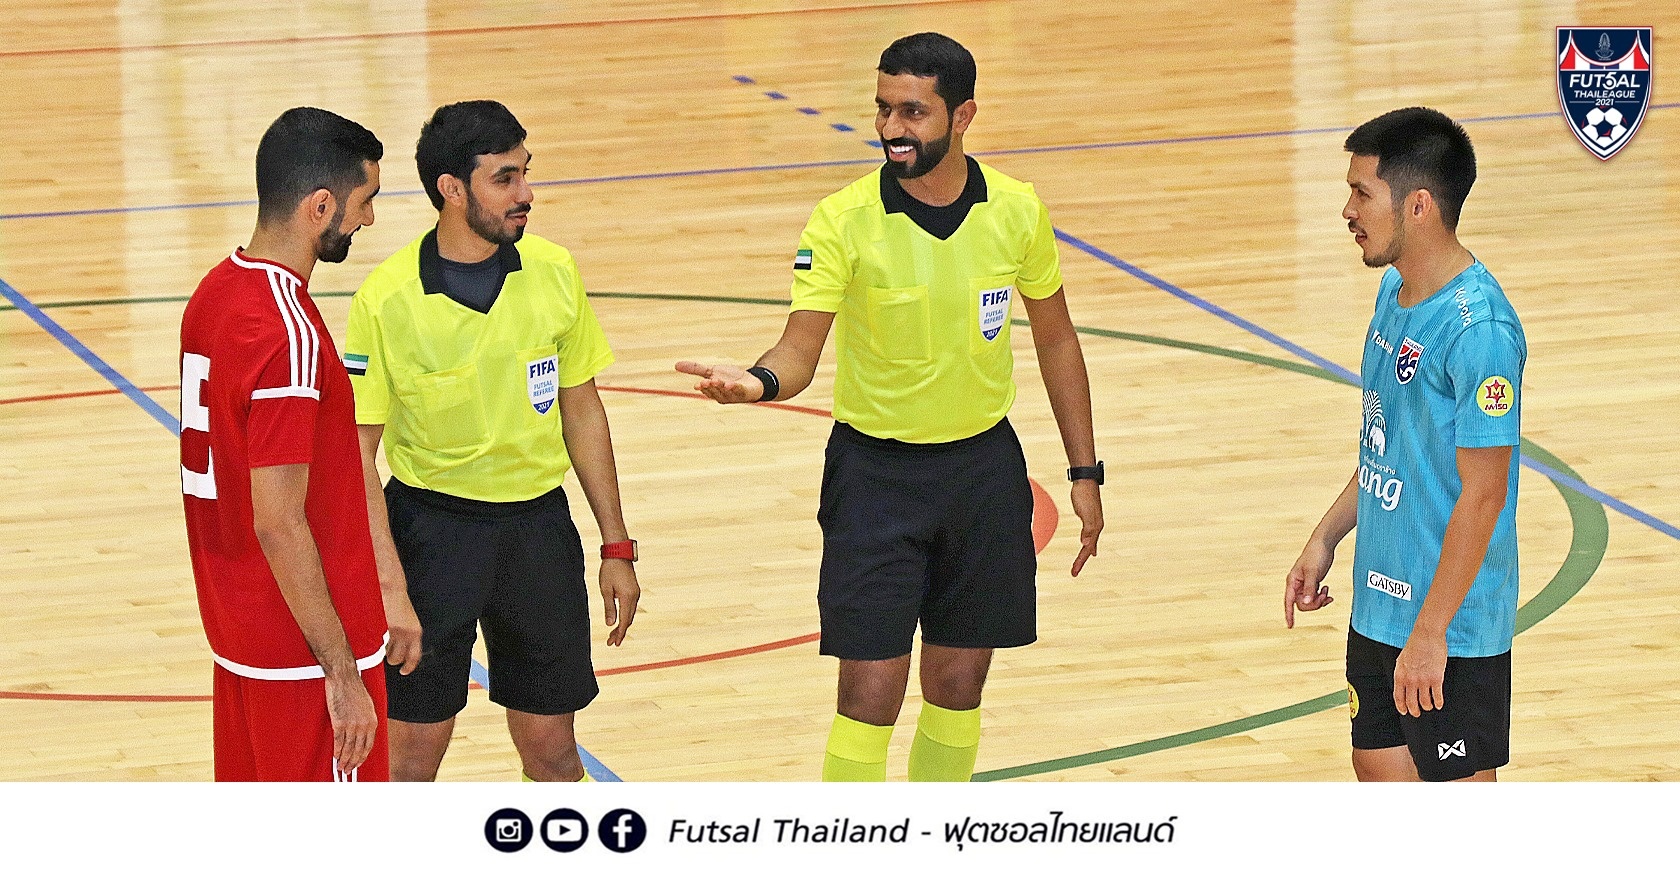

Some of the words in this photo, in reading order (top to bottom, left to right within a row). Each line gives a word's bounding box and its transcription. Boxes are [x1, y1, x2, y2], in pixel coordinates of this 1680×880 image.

[982, 289, 1009, 307] FIFA
[1454, 286, 1474, 327] Kubota
[529, 359, 556, 379] FIFA
[533, 380, 553, 391] FUTSAL
[1358, 465, 1404, 512] ang
[1369, 573, 1410, 599] GATSBY
